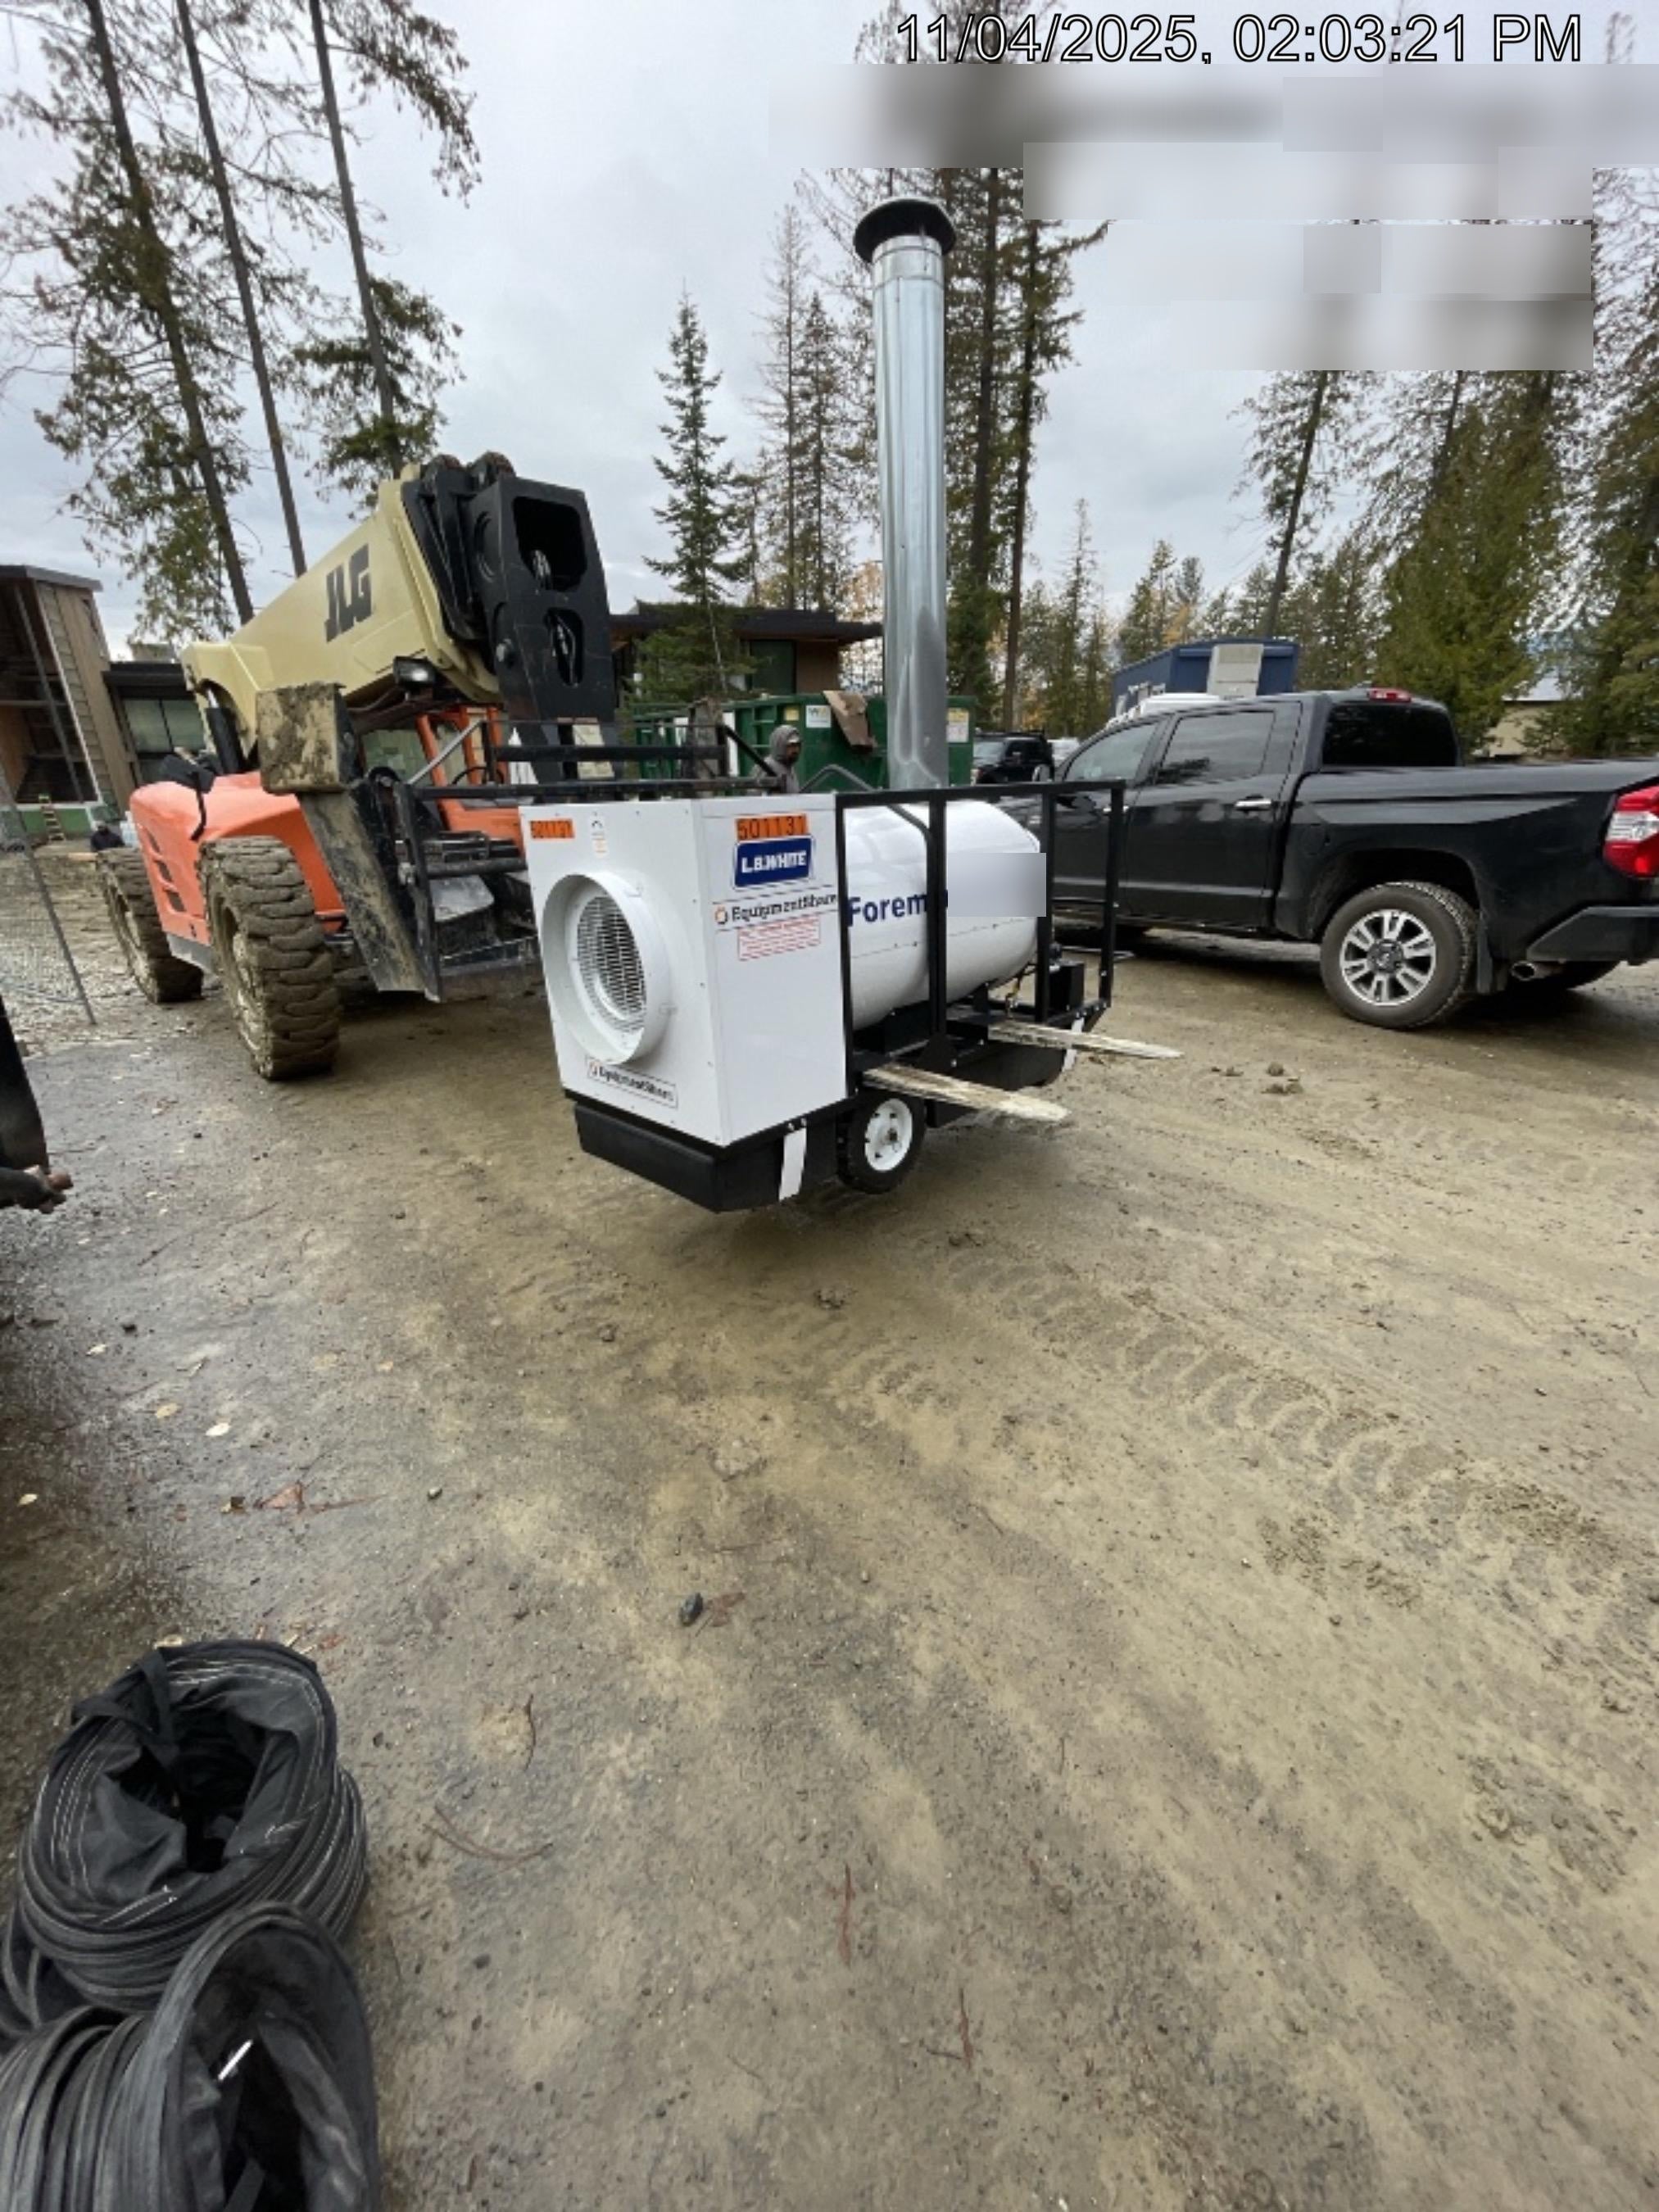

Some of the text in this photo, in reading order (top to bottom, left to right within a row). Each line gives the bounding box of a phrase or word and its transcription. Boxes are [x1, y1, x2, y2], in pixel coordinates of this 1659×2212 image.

[324, 544, 372, 643] JLG
[737, 816, 805, 841] 501131
[845, 890, 948, 927] Forem
